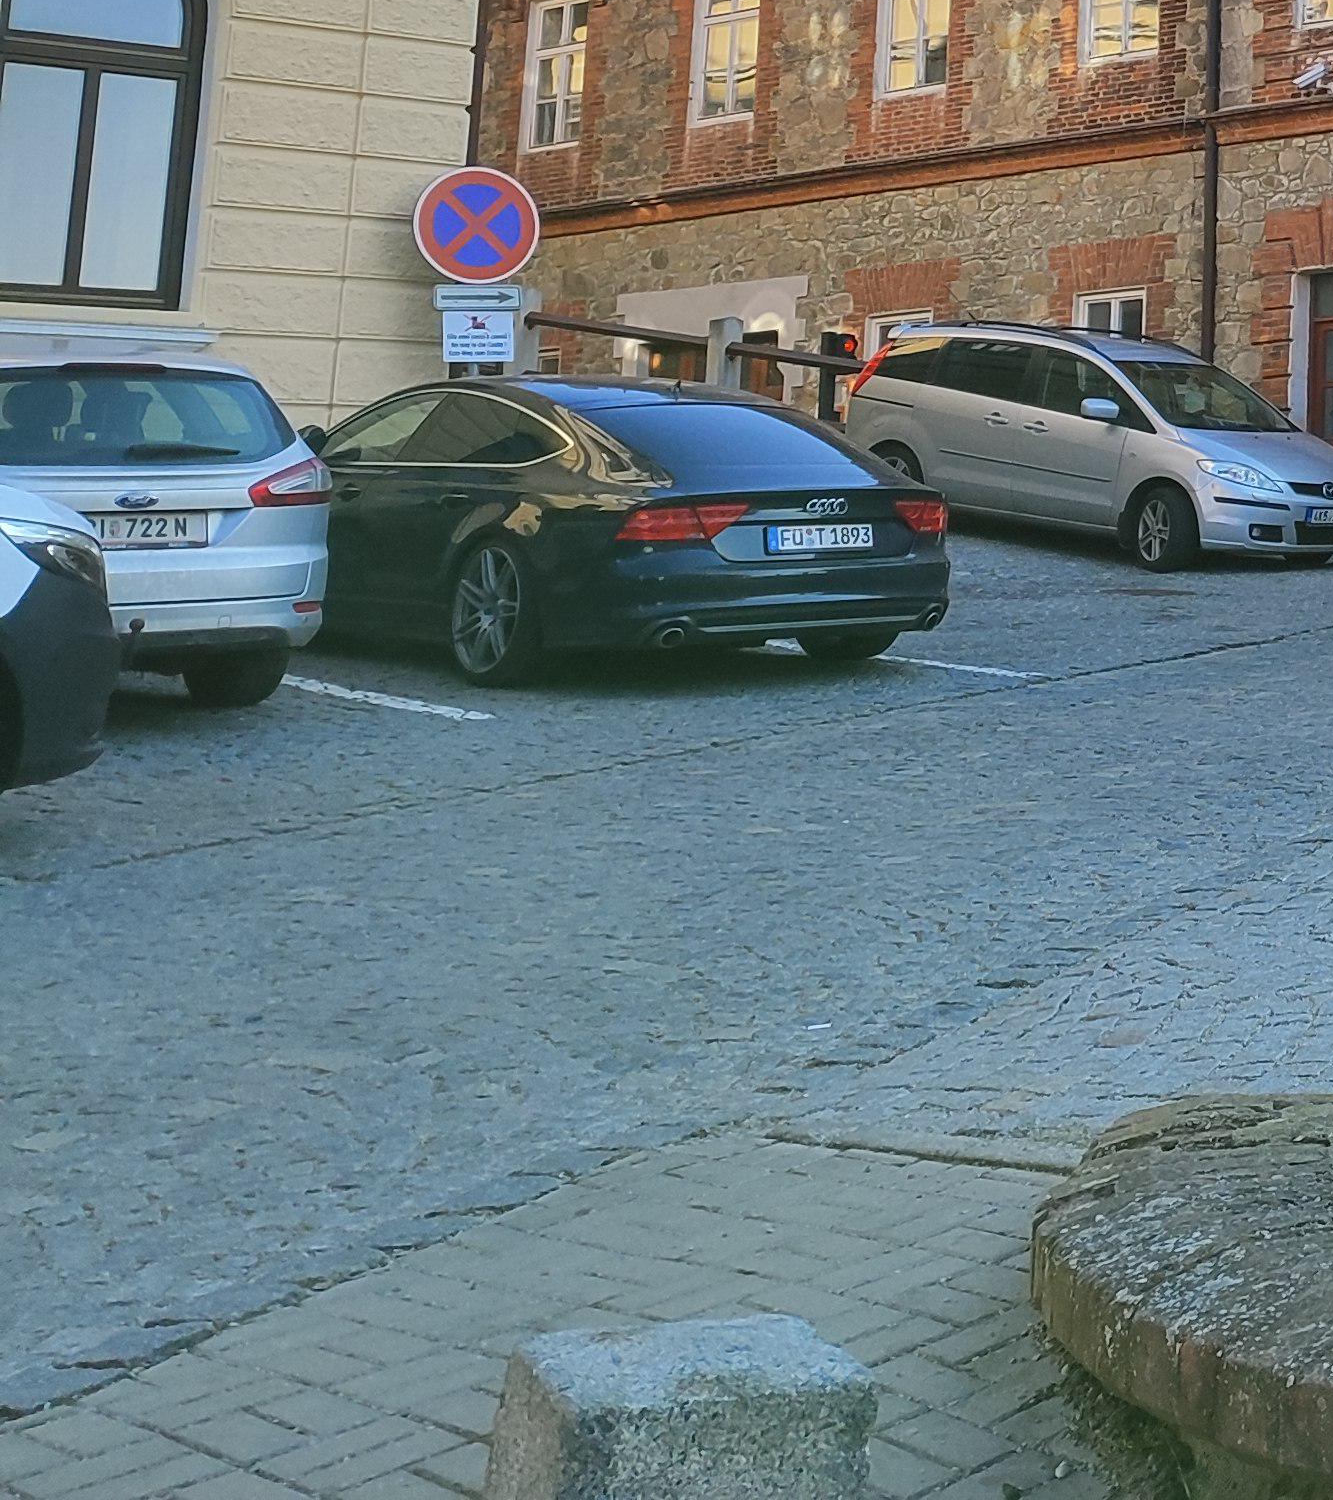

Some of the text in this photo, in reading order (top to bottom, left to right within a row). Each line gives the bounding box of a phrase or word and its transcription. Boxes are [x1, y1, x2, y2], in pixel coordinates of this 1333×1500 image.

[125, 517, 168, 539] 722
[173, 516, 188, 537] N
[830, 526, 871, 546] 1893
